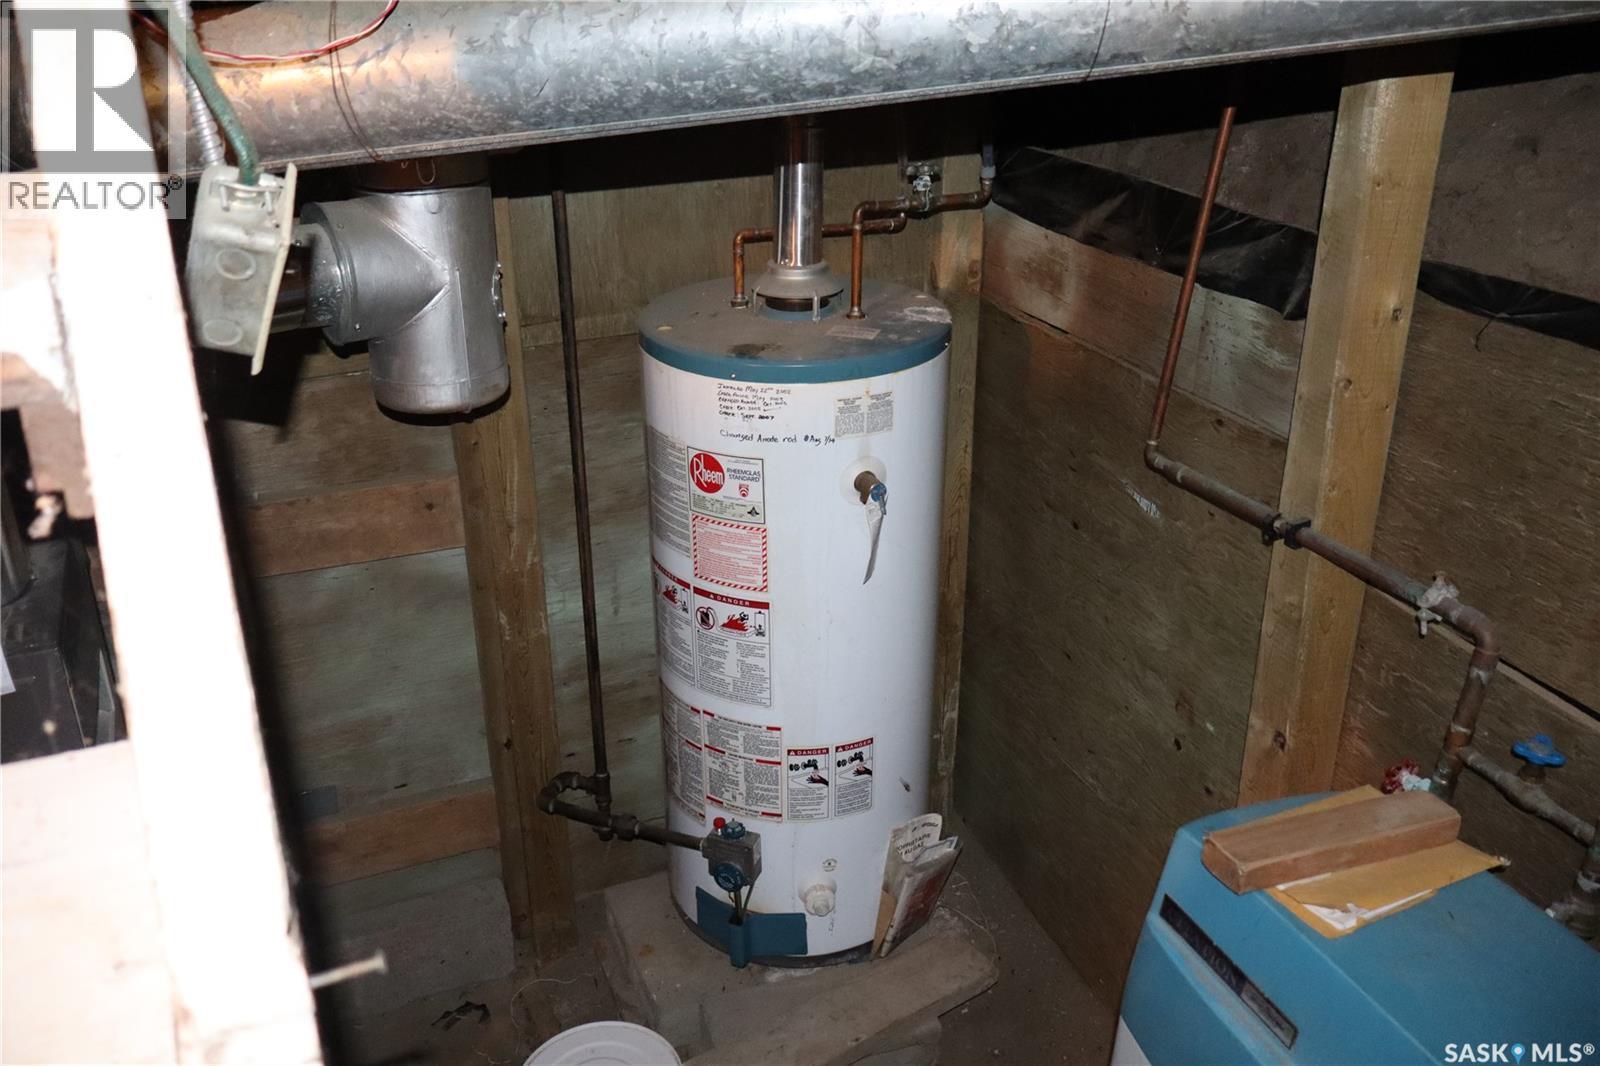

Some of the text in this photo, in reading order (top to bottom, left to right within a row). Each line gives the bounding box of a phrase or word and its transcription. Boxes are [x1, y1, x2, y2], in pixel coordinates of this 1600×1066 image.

[692, 453, 725, 488] Rheem
[728, 473, 760, 483] STANDARD
[716, 593, 750, 607] DANGER
[844, 739, 872, 751] DANGER
